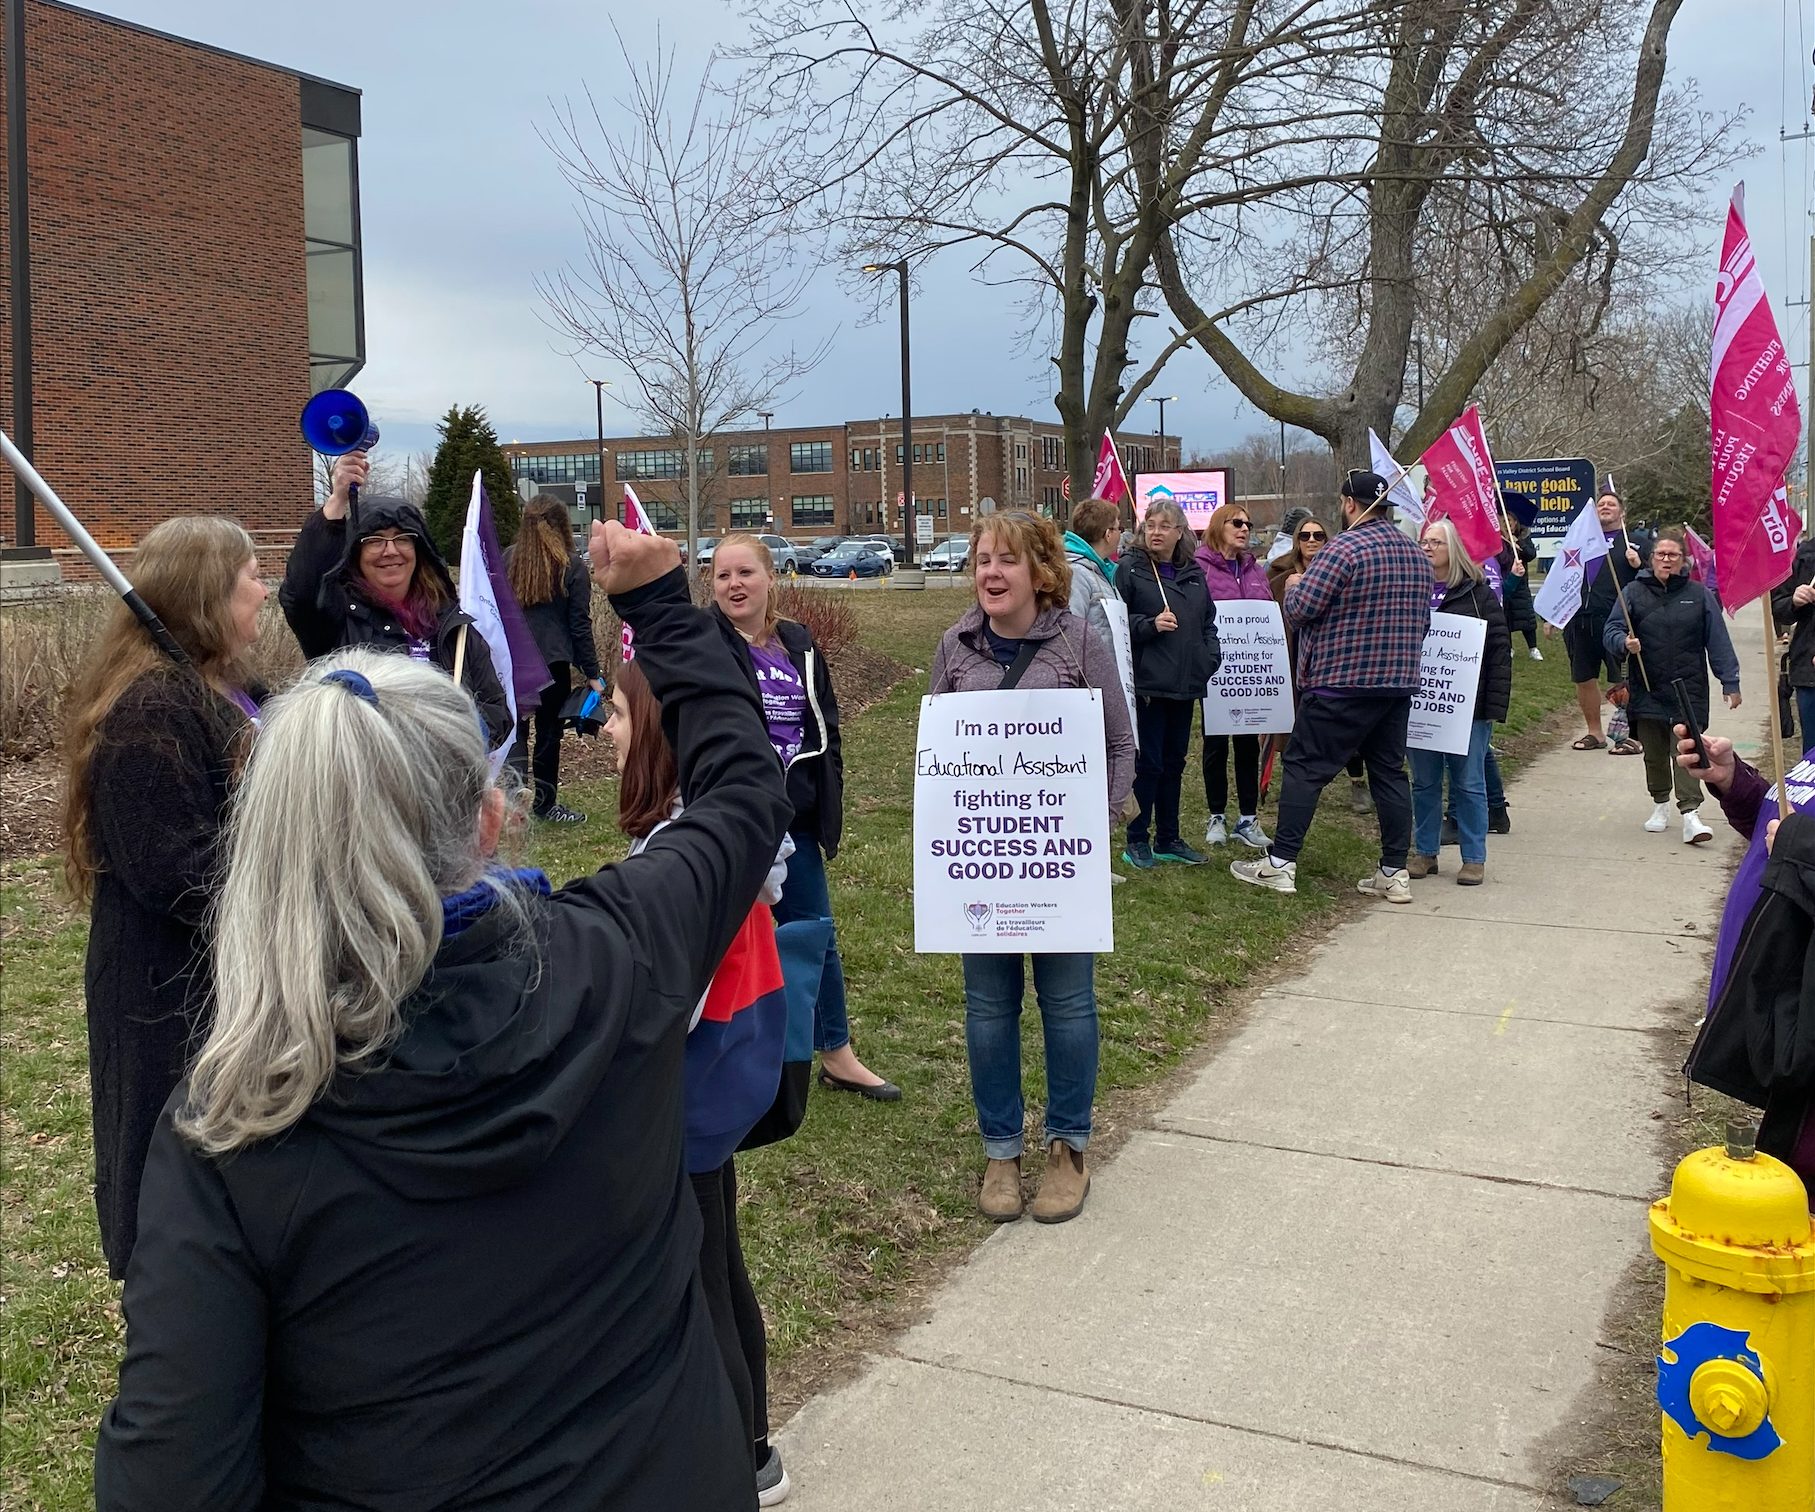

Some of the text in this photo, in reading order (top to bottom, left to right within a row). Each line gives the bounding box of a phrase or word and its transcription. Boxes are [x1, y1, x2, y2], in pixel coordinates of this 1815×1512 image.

[1537, 466, 1555, 474] School
[1505, 477, 1582, 495] have goals.
[1179, 501, 1217, 510] ALLEY
[1540, 496, 1575, 512] help.
[1483, 501, 1500, 530] Ontario
[1537, 516, 1558, 524] options
[1546, 524, 1571, 532] Educat
[1760, 504, 1785, 546] ario
[1219, 615, 1235, 624] I'm
[1245, 615, 1270, 625] proud
[1218, 632, 1285, 646] cational Assistant
[1428, 627, 1462, 640] proud
[1221, 651, 1274, 662] fighting for
[1437, 646, 1480, 665] Assistant
[1224, 664, 1273, 674] STUDENT
[1440, 665, 1456, 676] for
[1211, 676, 1285, 686] SUCCESS AND
[1420, 678, 1453, 690] DENT
[1220, 688, 1279, 698] GOOD JOBS
[1438, 693, 1466, 704] AND
[1423, 702, 1455, 715] JOBS
[955, 717, 1063, 739] I'm a proud
[918, 748, 1088, 778] Educational Assistant
[953, 789, 1067, 811] fighting for
[957, 816, 1064, 835] STUDENT
[931, 838, 1092, 857] SUCCESS AND
[948, 861, 1076, 880] GOOD JOBS
